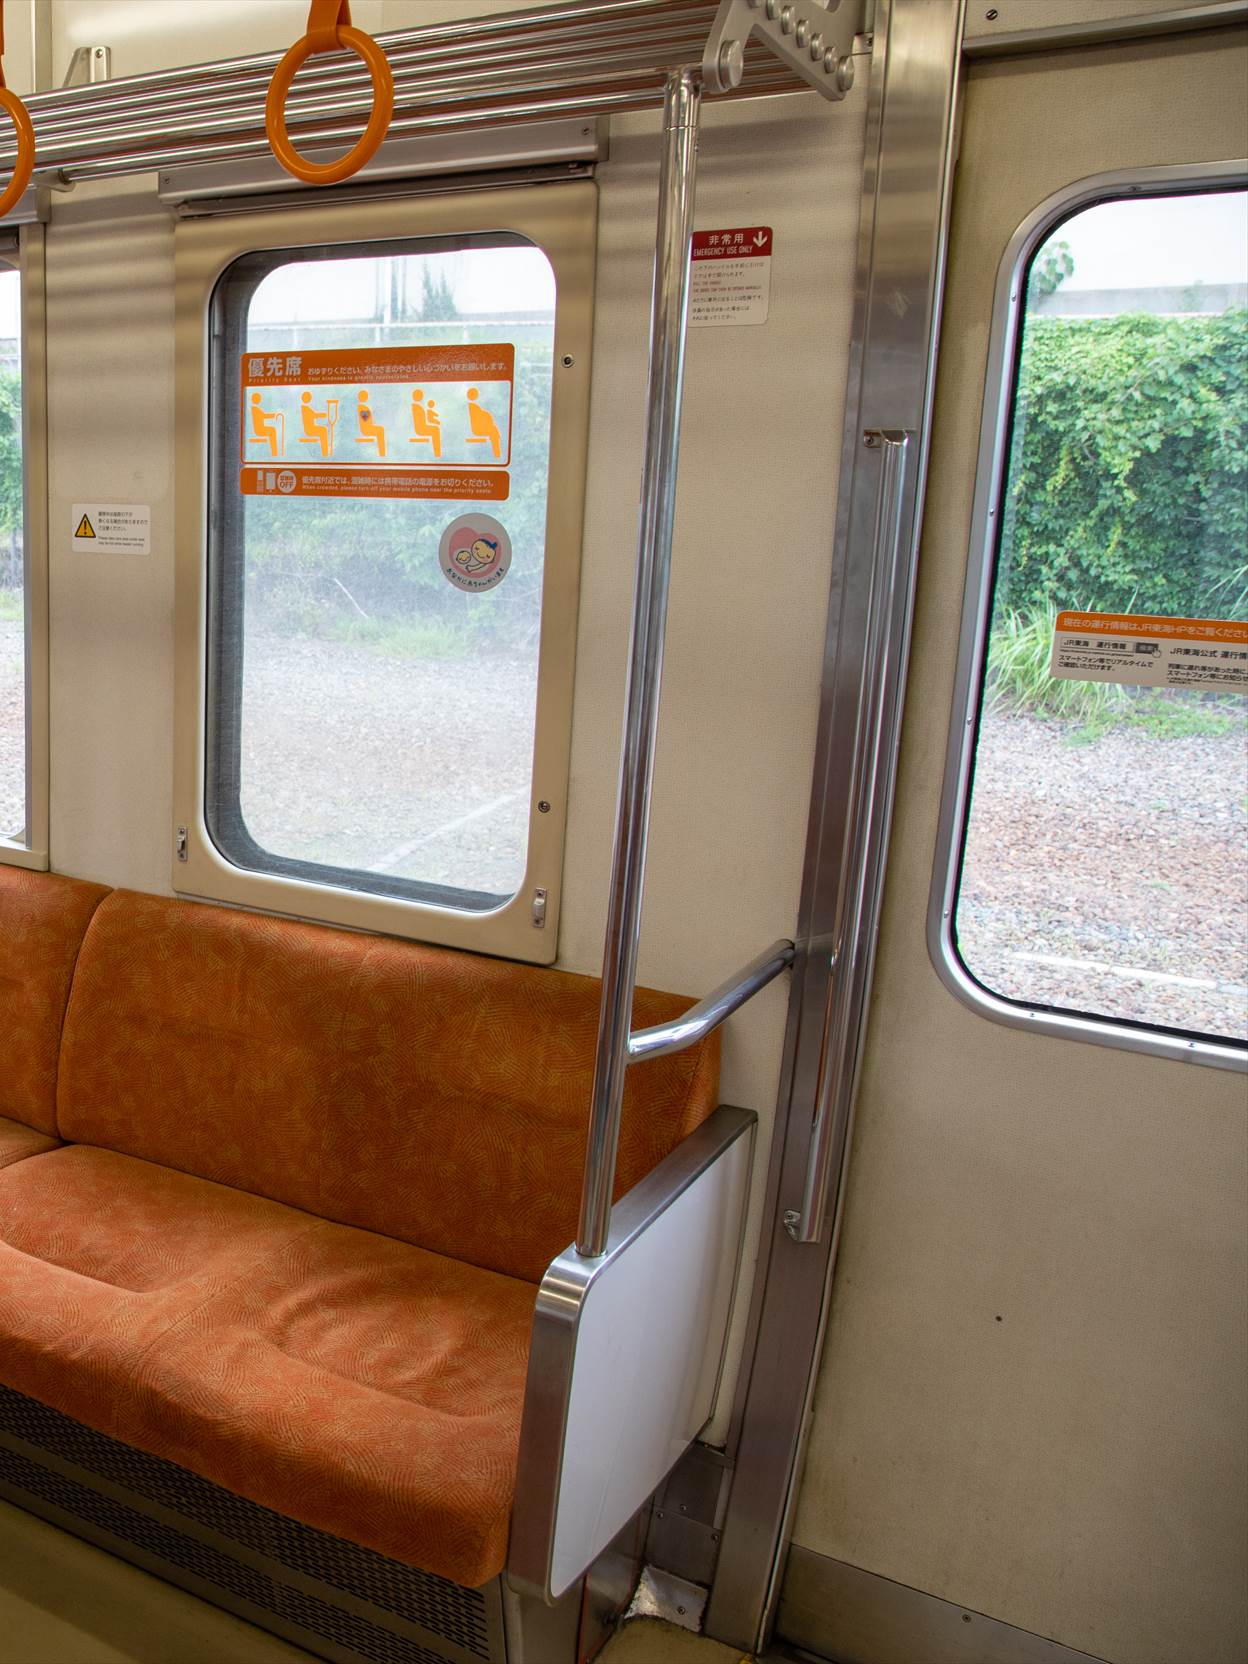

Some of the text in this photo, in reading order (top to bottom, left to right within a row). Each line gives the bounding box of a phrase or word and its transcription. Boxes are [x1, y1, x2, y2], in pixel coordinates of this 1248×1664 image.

[708, 233, 744, 246] 非常用
[693, 245, 753, 256] EMERGENCY USE ONLY
[248, 356, 302, 377] 優先席
